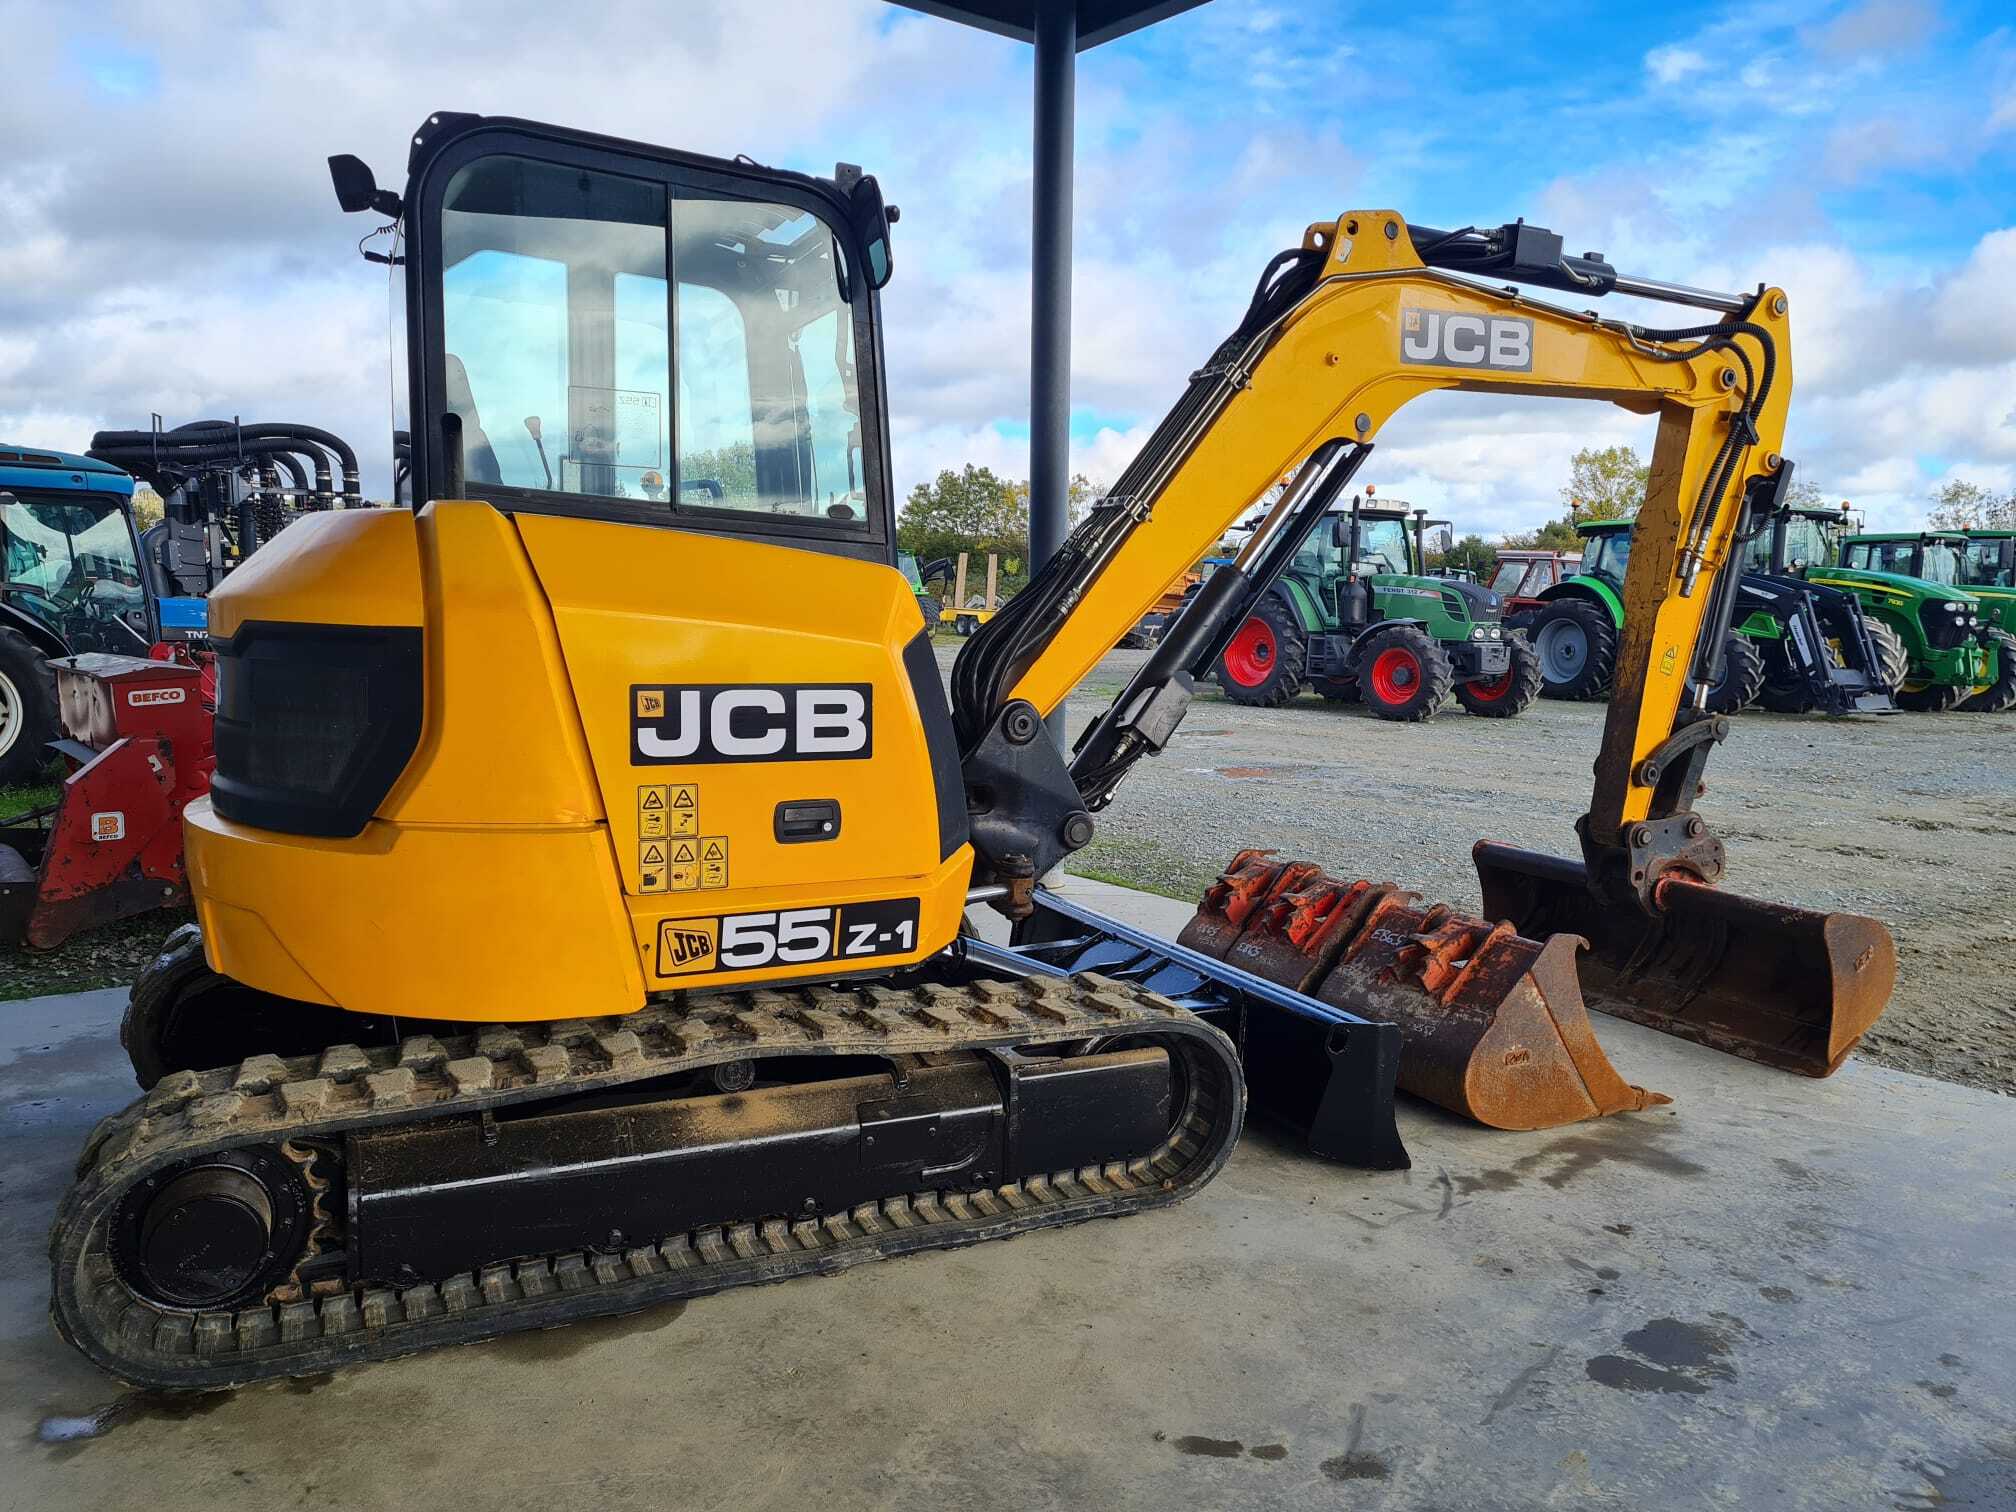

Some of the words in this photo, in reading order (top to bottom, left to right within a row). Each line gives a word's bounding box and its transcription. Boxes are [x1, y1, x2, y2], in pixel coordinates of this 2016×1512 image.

[1404, 313, 1530, 366] JCB
[132, 690, 181, 703] BEFCO
[638, 689, 867, 758] JCB
[673, 931, 710, 962] JCB
[721, 909, 831, 968] 55
[846, 920, 913, 955] Z-1
